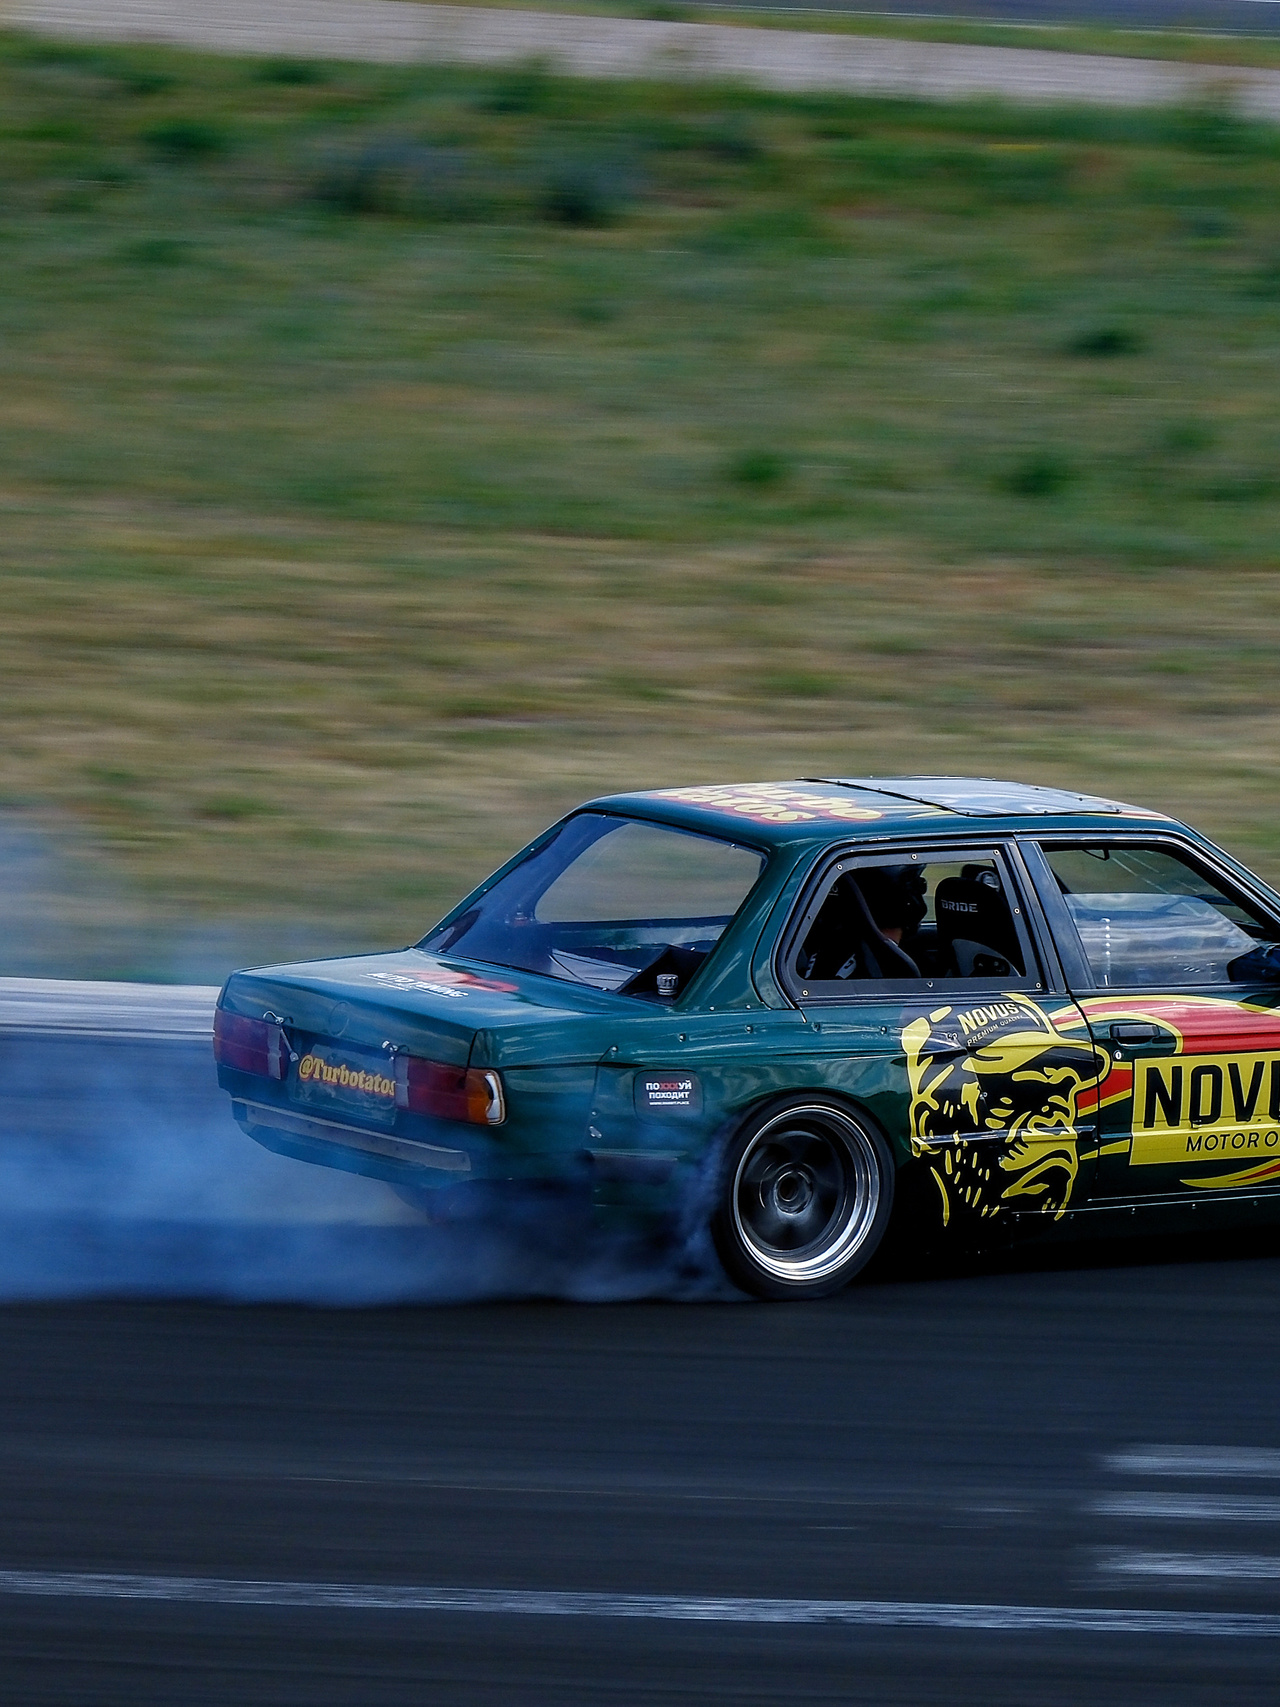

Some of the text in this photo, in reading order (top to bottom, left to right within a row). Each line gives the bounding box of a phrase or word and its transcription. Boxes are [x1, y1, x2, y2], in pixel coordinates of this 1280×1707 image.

[941, 899, 979, 913] BRIDE
[957, 1003, 1020, 1036] NOVUS
[966, 1023, 999, 1047] PREMIUM
[299, 1054, 396, 1097] @Turbotatos
[648, 1091, 690, 1100] ПОХОДИТ
[1185, 1131, 1260, 1152] MOTOR
